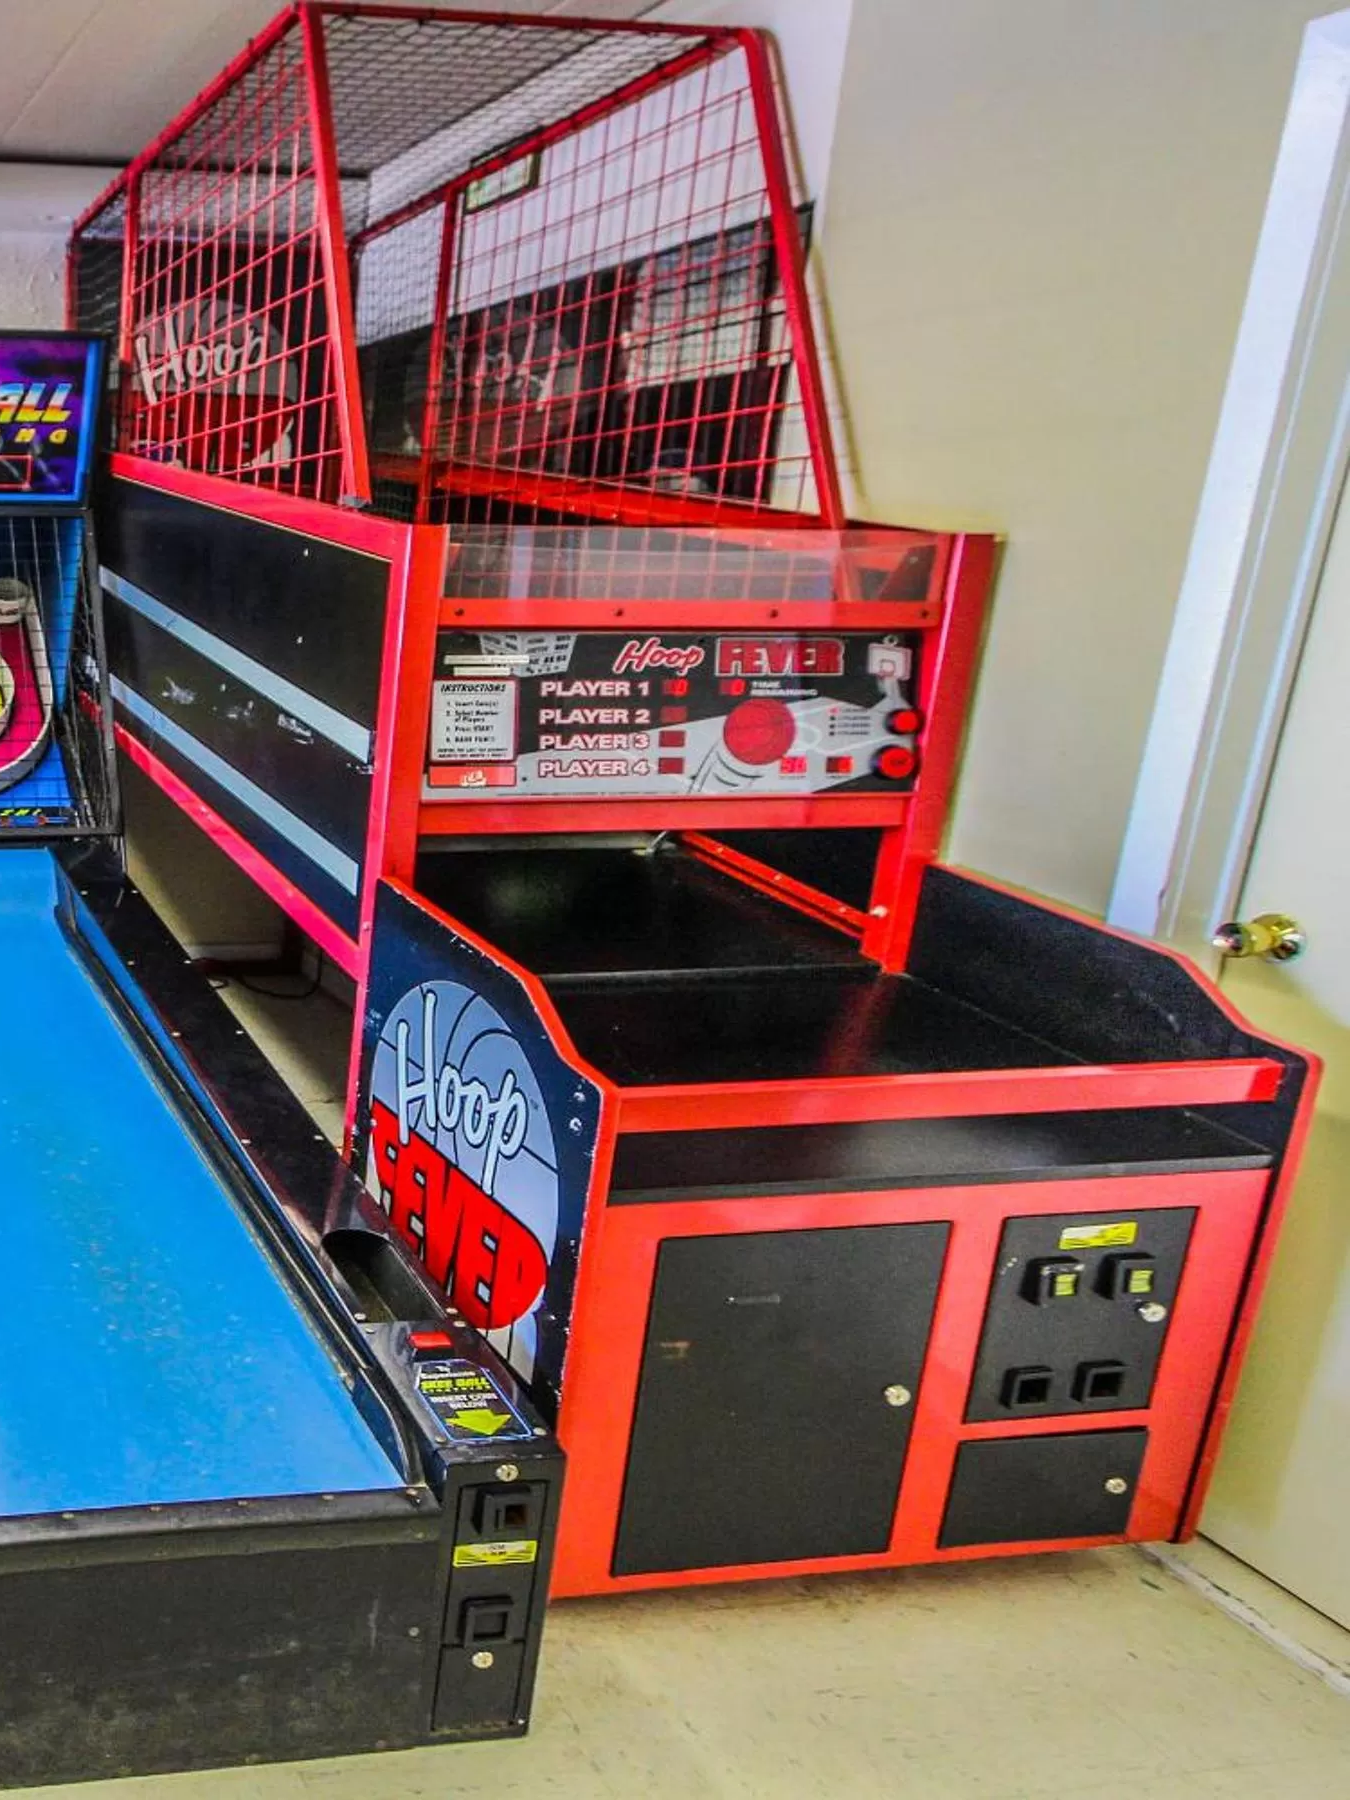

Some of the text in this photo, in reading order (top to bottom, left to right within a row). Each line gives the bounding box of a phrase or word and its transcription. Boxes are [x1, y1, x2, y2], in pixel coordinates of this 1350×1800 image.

[613, 637, 705, 676] Hoop
[715, 637, 846, 676] FEVER
[441, 684, 507, 693] INSTRUCTIONS
[540, 680, 650, 697] PLAYER 1
[539, 708, 650, 724] PLAYER 2
[539, 733, 649, 750] PLAYER 3
[539, 760, 649, 777] PLAYER 4
[396, 989, 529, 1196] Hoop
